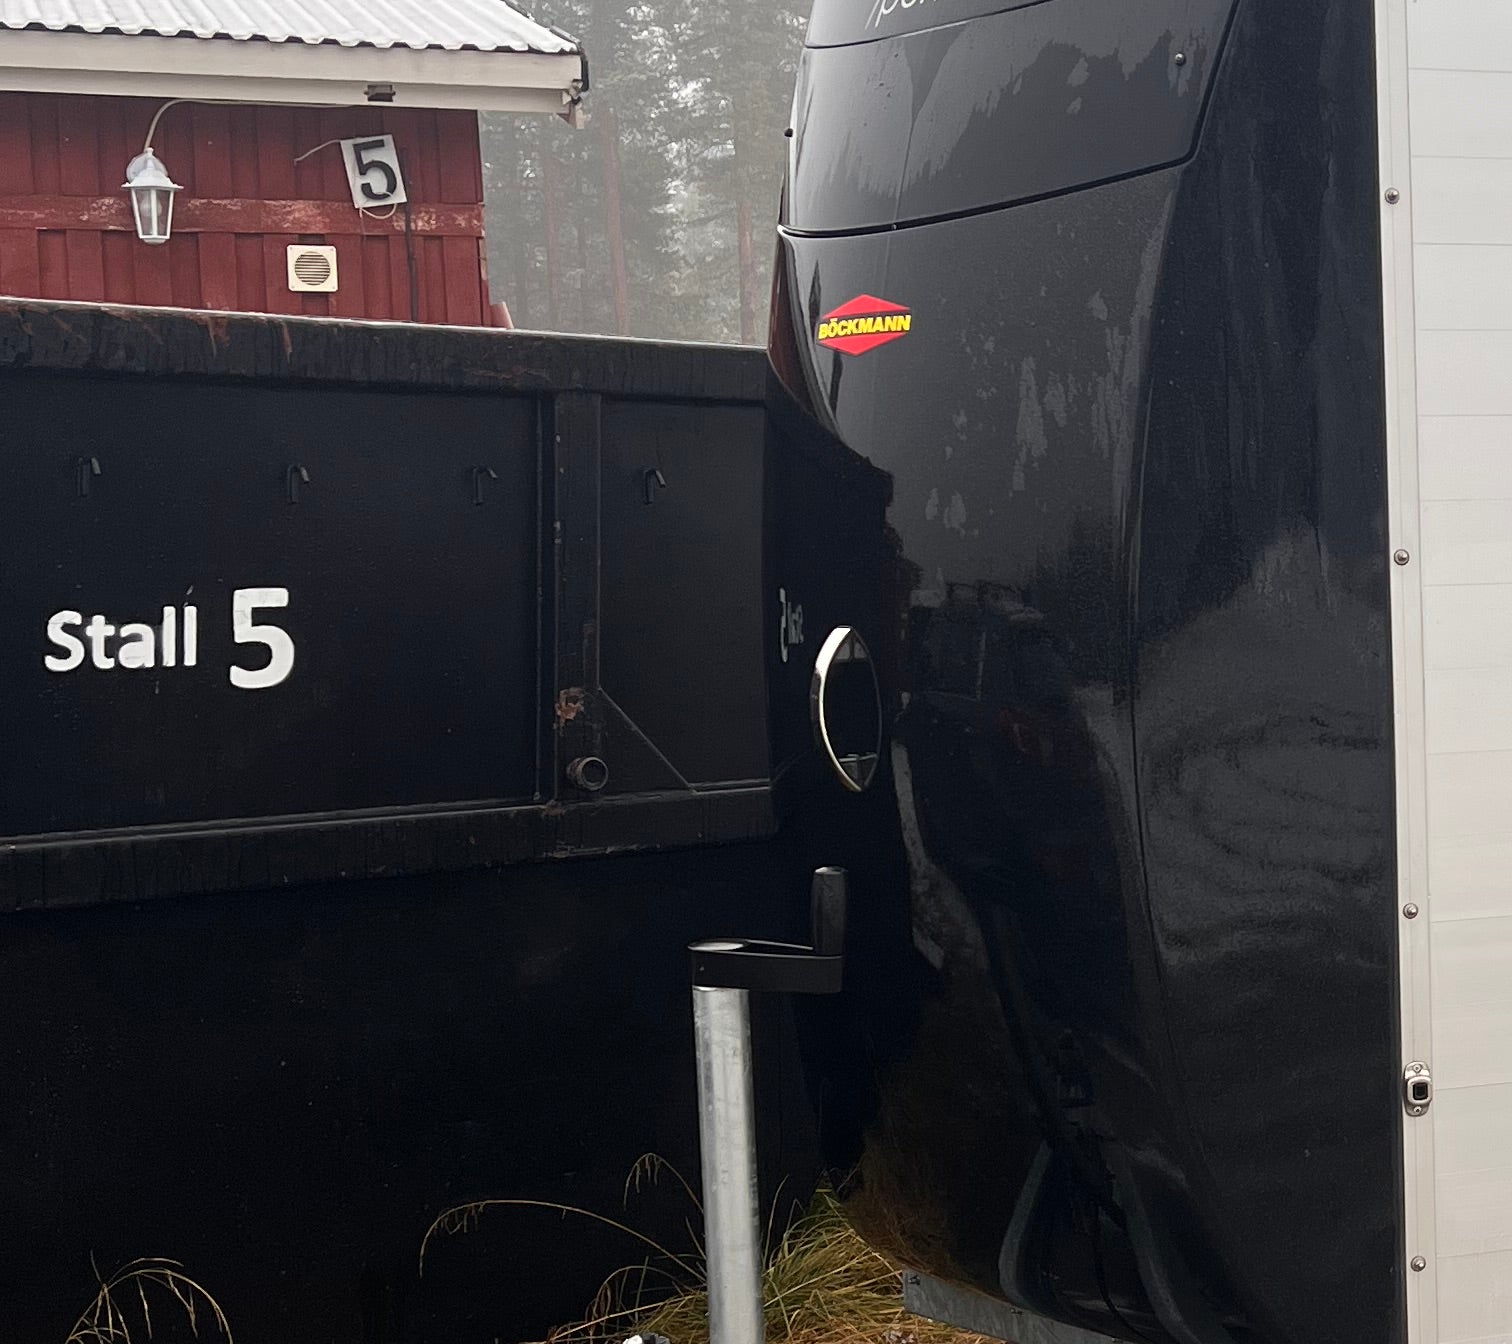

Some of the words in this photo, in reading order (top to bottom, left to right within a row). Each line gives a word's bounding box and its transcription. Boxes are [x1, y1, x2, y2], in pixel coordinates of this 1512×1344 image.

[352, 139, 397, 200] 5
[818, 315, 911, 340] BÖCKMANN
[44, 610, 197, 672] Stall
[229, 587, 295, 689] 5
